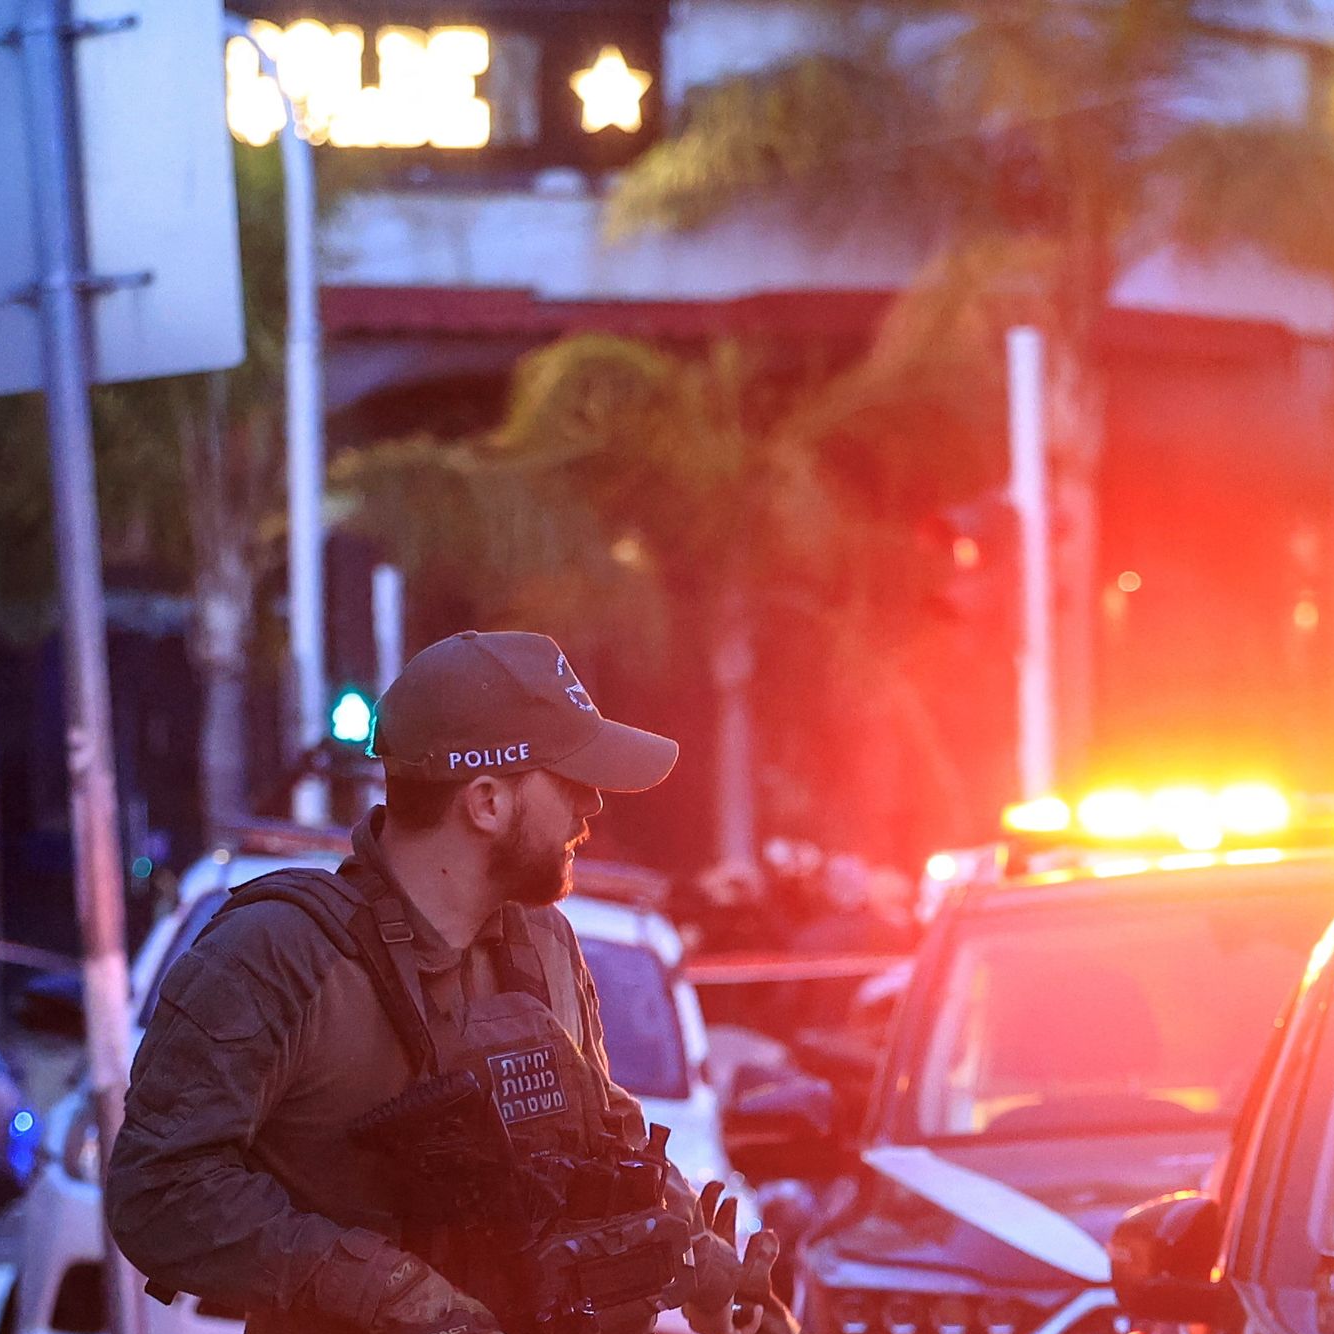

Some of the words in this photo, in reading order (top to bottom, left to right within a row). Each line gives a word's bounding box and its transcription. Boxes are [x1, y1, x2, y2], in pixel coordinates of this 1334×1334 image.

[449, 743, 530, 769] POLICE
[501, 1051, 549, 1076] יחידת
[502, 1071, 555, 1096] כוננות
[501, 1091, 563, 1119] משטרה
